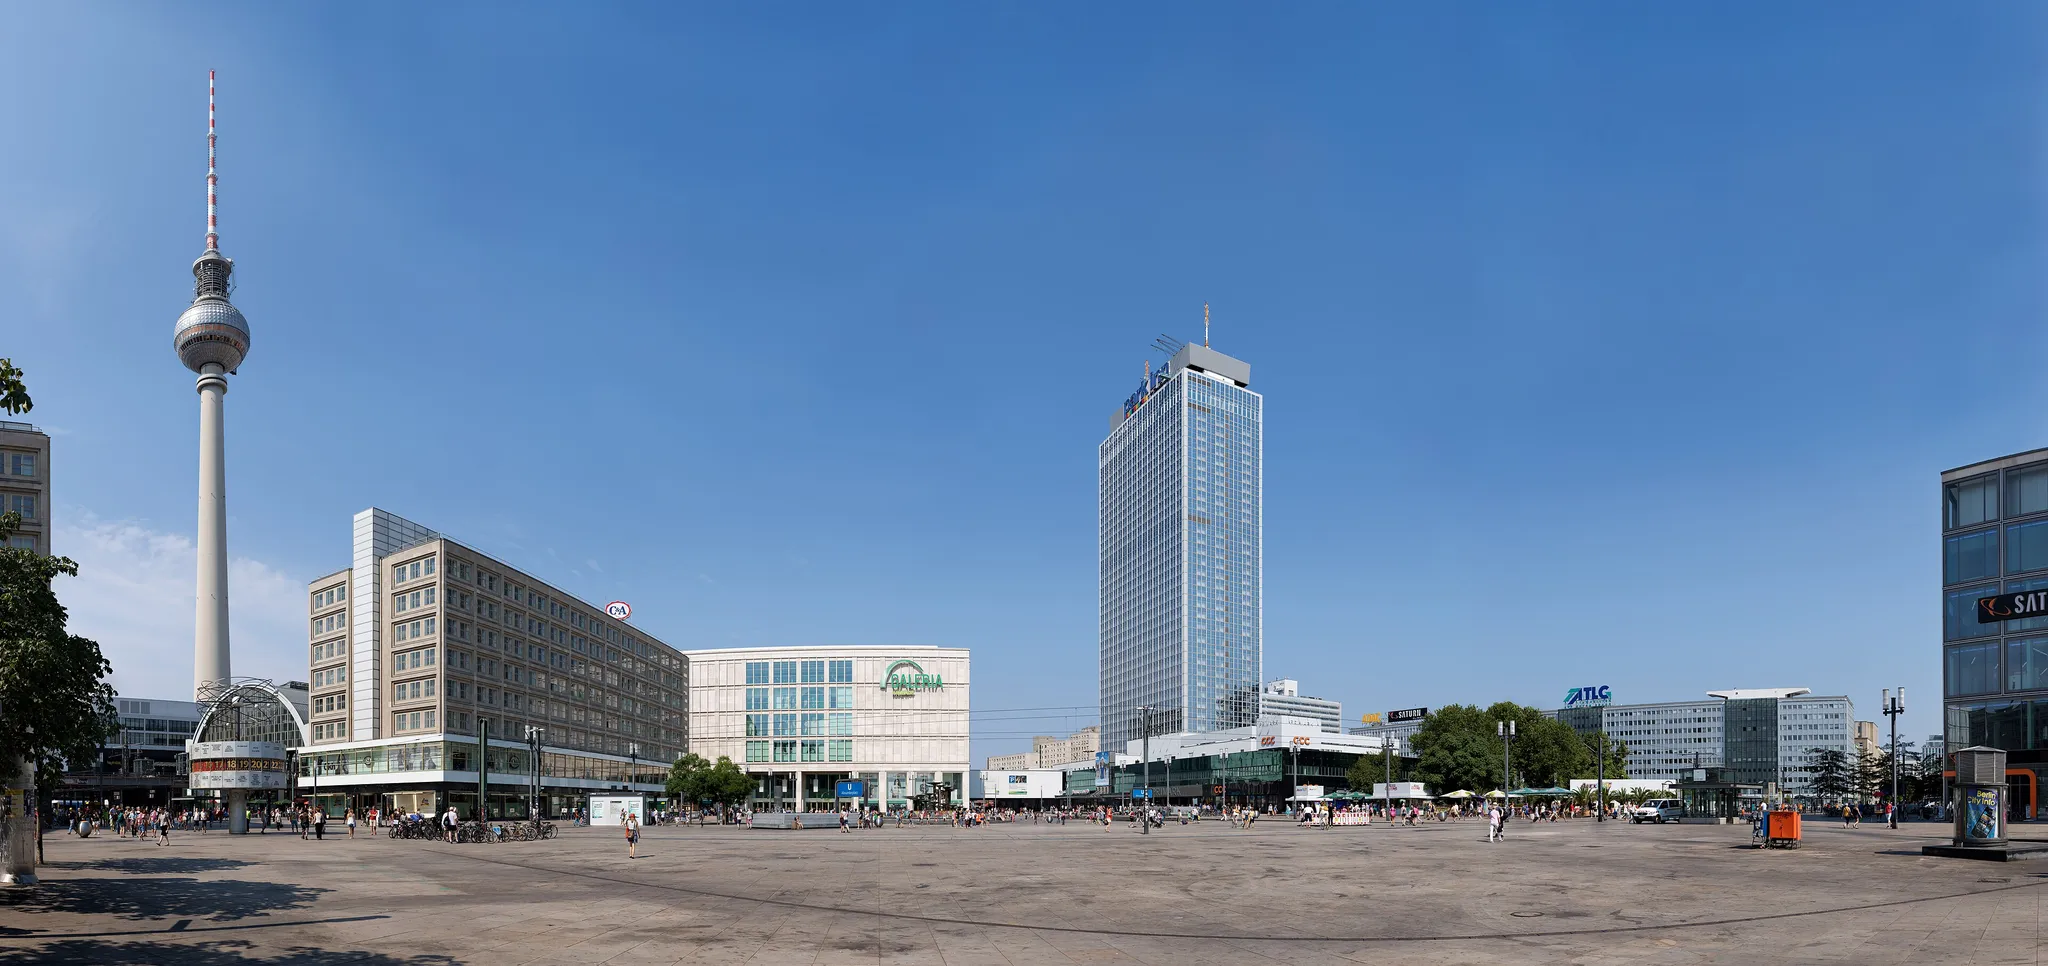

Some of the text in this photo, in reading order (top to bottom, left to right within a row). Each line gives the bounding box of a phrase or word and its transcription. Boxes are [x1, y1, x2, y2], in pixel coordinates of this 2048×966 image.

[609, 605, 627, 615] C&A
[891, 673, 943, 689] GALERIA
[1398, 709, 1421, 719] SATURN
[1293, 736, 1310, 745] CCC
[227, 760, 237, 769] 18
[240, 760, 249, 769] 19
[251, 760, 262, 769] 20
[271, 761, 279, 769] 22
[847, 783, 853, 791] U
[1977, 790, 1996, 799] Berlin
[1967, 796, 1996, 806] City Info
